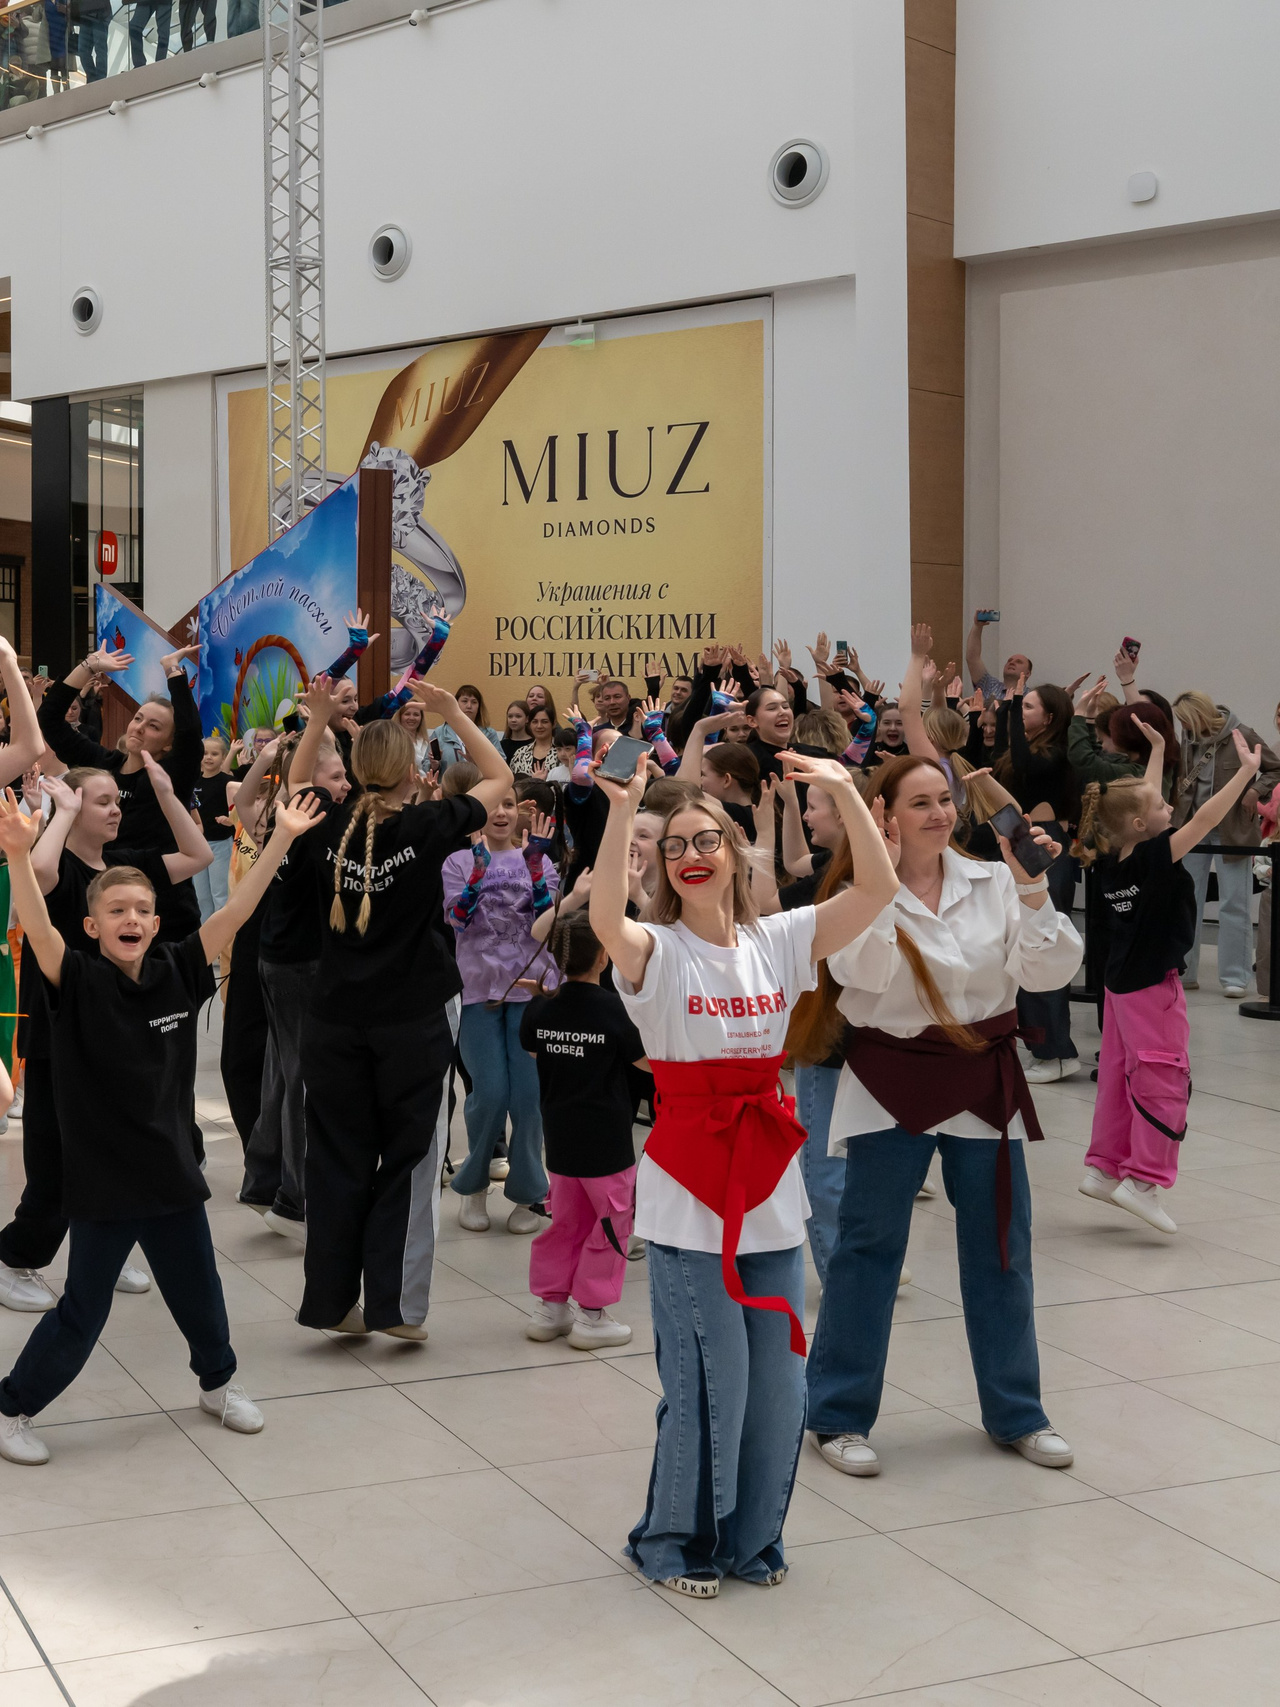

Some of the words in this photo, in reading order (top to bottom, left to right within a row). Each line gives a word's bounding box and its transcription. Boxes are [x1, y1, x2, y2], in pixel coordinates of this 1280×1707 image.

[390, 361, 490, 436] MIUZ
[502, 421, 710, 506] MIUZ
[543, 516, 656, 538] DIAMONDS
[212, 577, 285, 637] Светлой
[288, 585, 333, 635] пасхи
[537, 581, 652, 606] Украшения
[658, 582, 669, 600] с
[495, 607, 718, 641] РОССИЙСКИМИ
[688, 986, 788, 1018] BURBERR
[149, 1011, 189, 1028] ТЕРРИТОРИЯ
[536, 1028, 605, 1044] ЕРРИТОРИЯ
[546, 1043, 584, 1057] ПОБЕД
